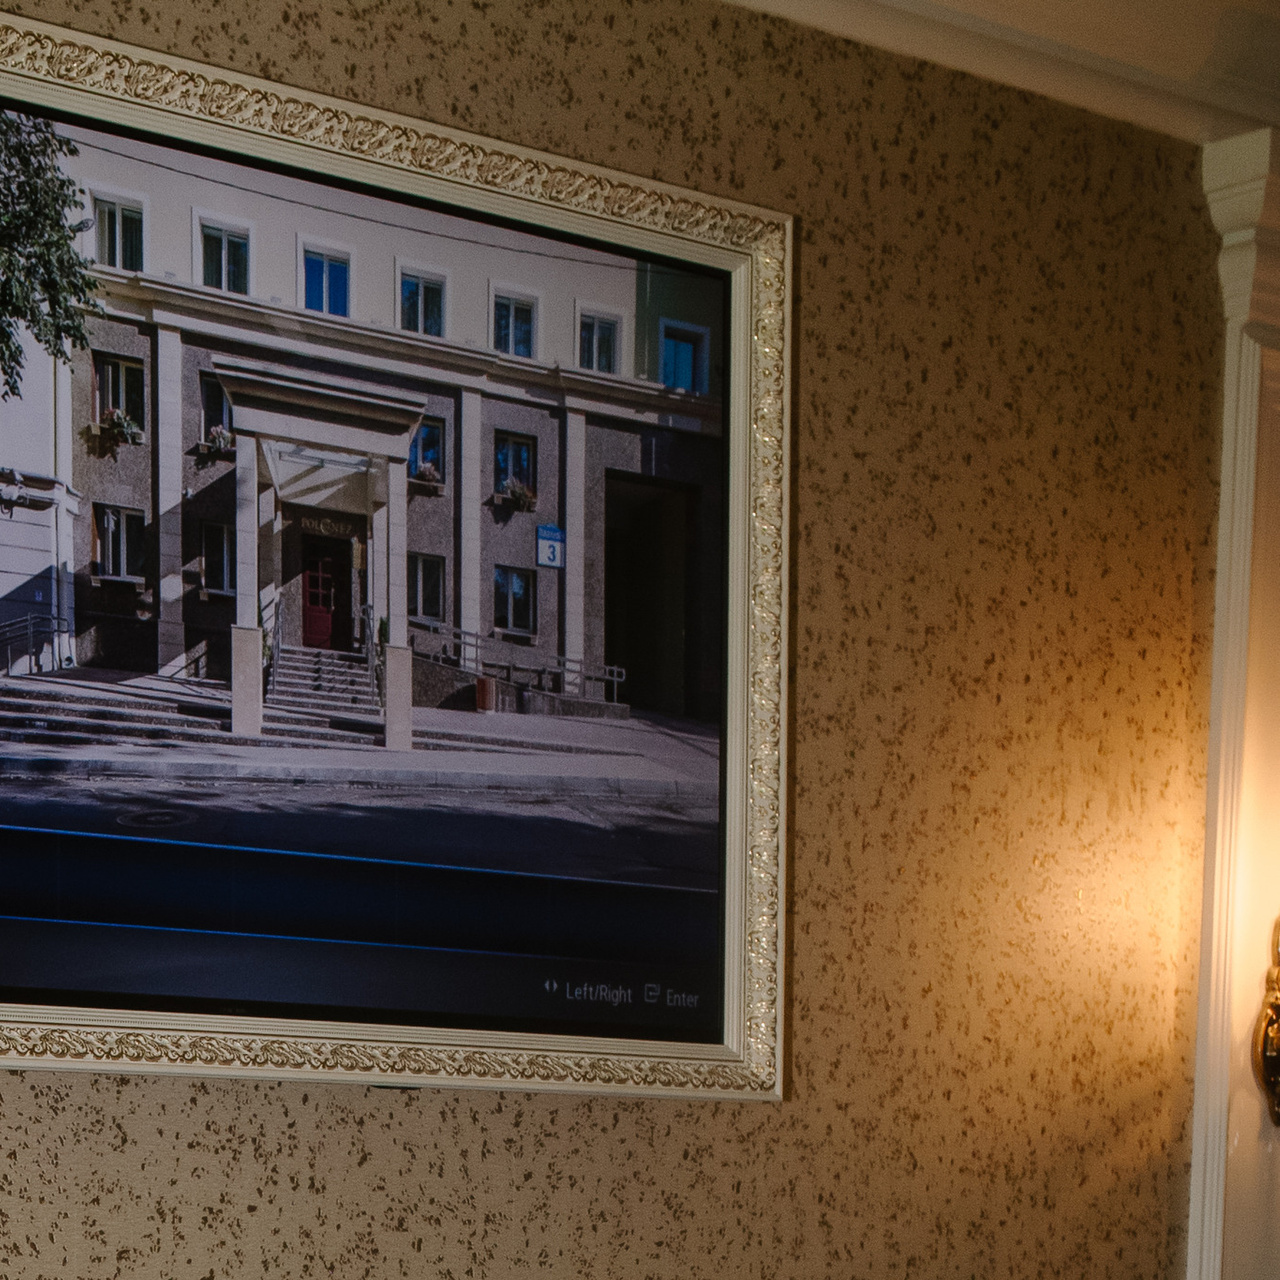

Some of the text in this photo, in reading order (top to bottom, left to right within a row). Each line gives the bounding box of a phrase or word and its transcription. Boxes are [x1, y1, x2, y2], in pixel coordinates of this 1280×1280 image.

[547, 544, 556, 562] 3
[566, 982, 699, 1008] Left/Right Enter
